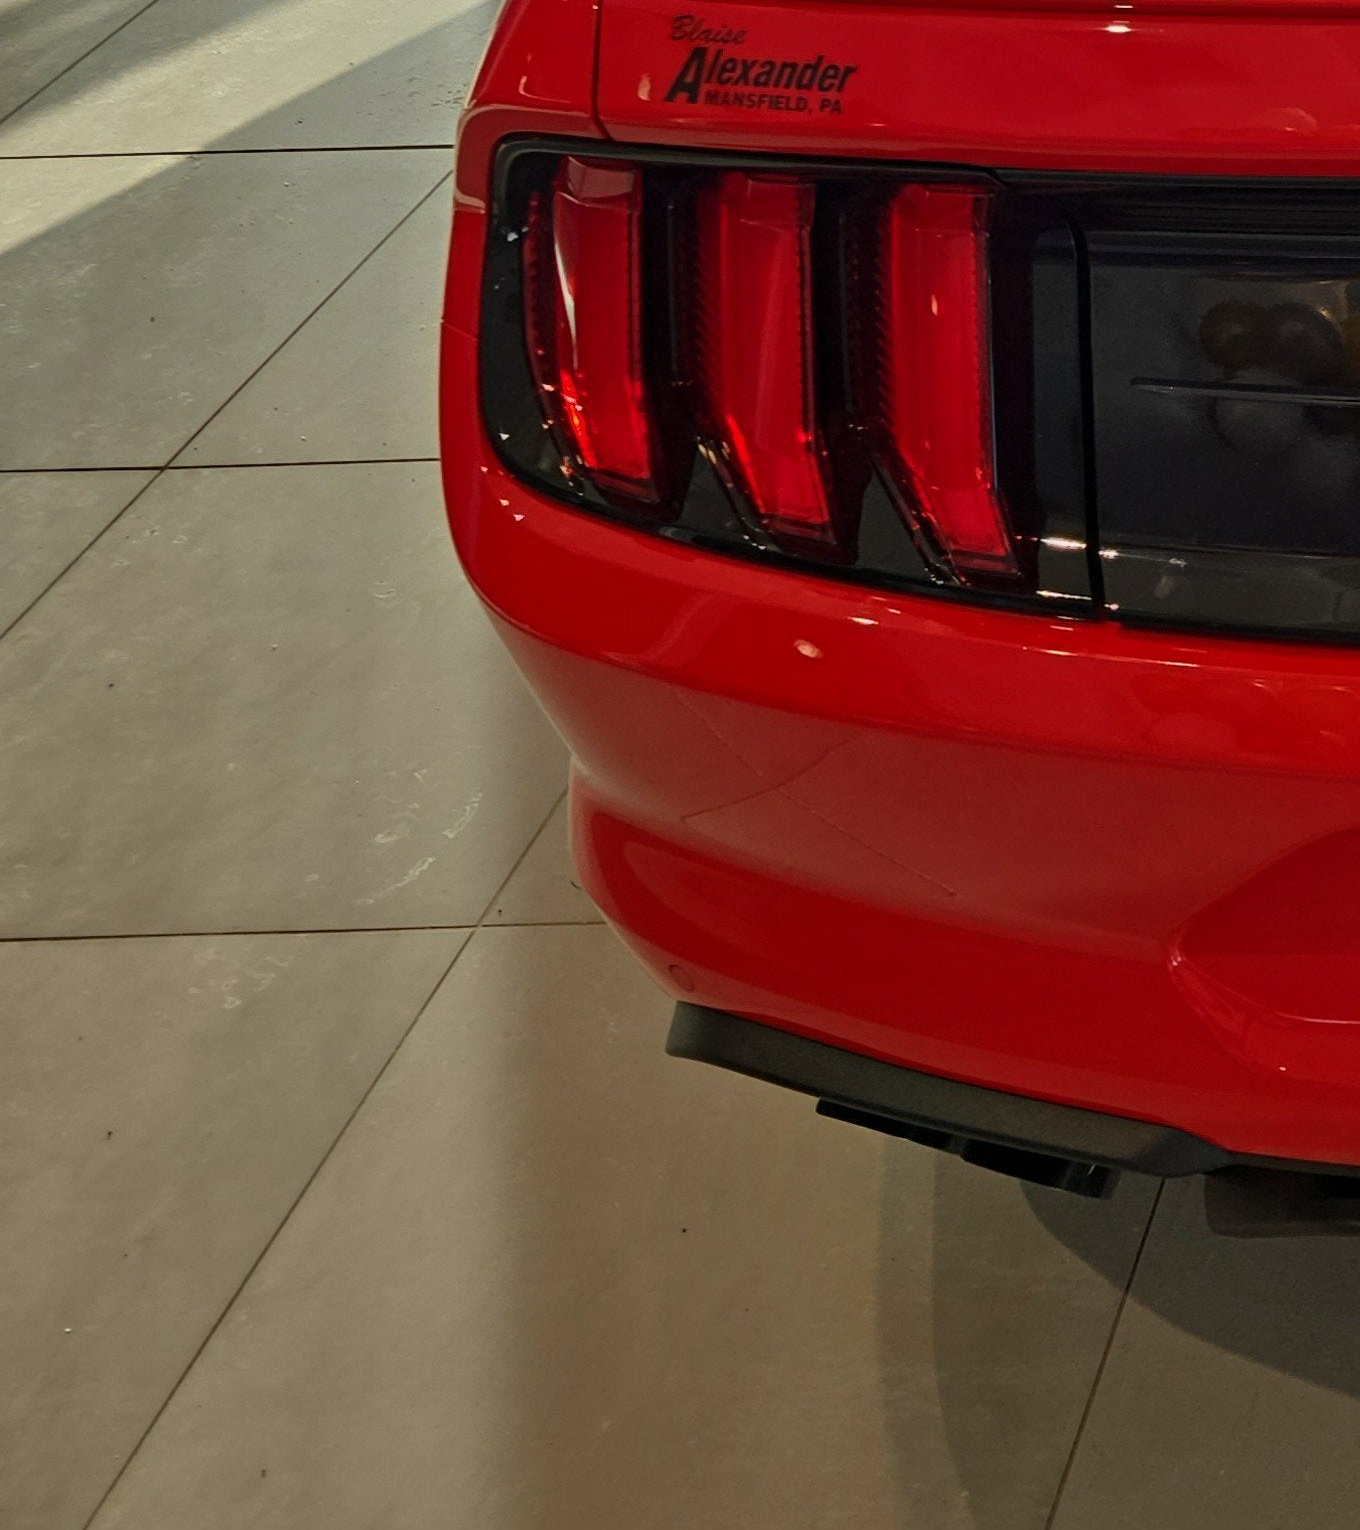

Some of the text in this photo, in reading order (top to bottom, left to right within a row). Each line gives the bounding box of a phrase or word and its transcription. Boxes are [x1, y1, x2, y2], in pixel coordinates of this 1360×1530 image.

[670, 13, 748, 45] Blaise
[663, 46, 859, 104] Alexander
[704, 89, 843, 116] MANSFIELD, PA
